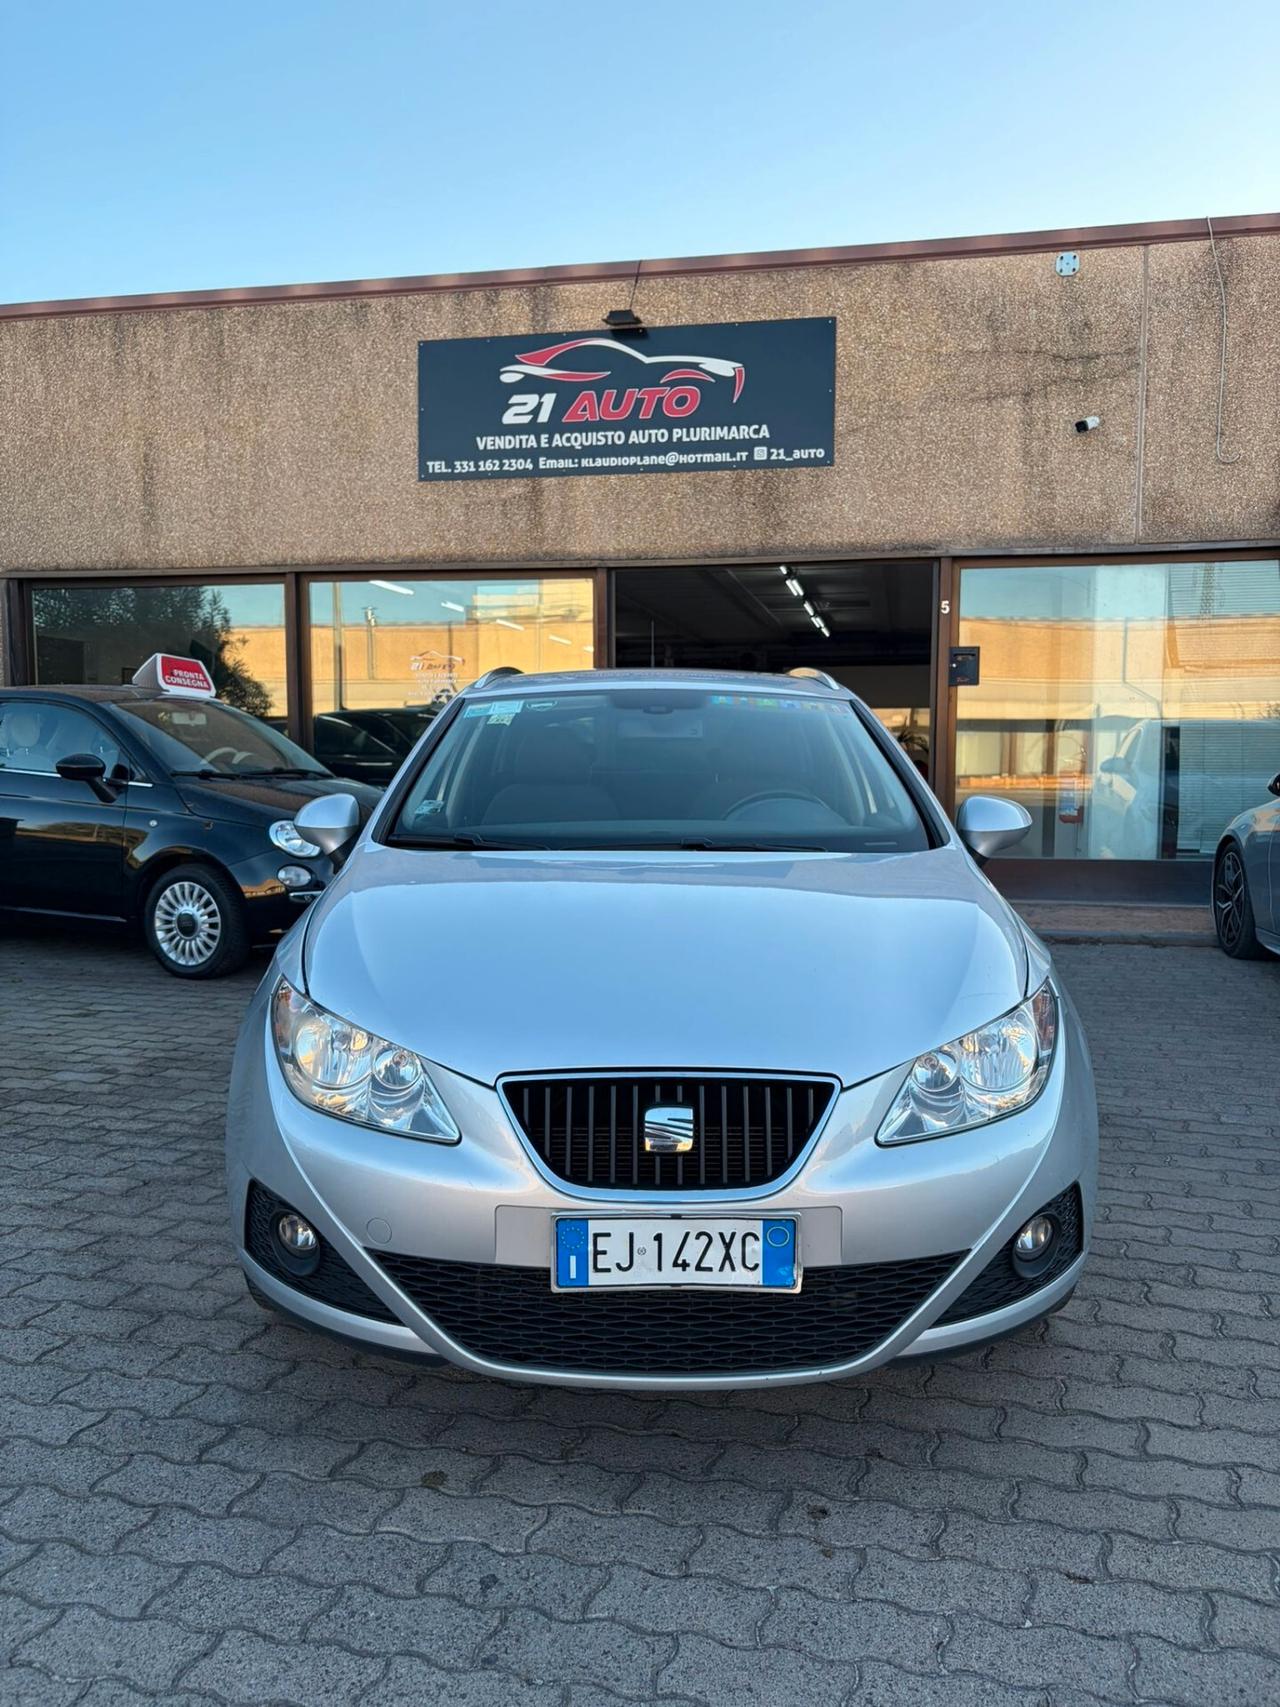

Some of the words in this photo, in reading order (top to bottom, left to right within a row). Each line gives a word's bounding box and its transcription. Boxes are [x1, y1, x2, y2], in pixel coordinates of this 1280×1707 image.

[502, 392, 557, 424] 21
[562, 386, 701, 422] AUTO
[476, 434, 537, 450] VENDITA
[540, 433, 549, 448] E
[552, 430, 626, 449] ACQUISTO
[628, 427, 669, 445] AUTO
[672, 424, 770, 443] PLURIMARCA
[426, 460, 452, 474] TEL.
[453, 460, 476, 473] 331
[478, 459, 500, 472] 162
[502, 458, 534, 472] 2304
[940, 600, 951, 615] 5
[164, 675, 209, 688] CONSEGNA
[172, 669, 205, 680] PRONTA
